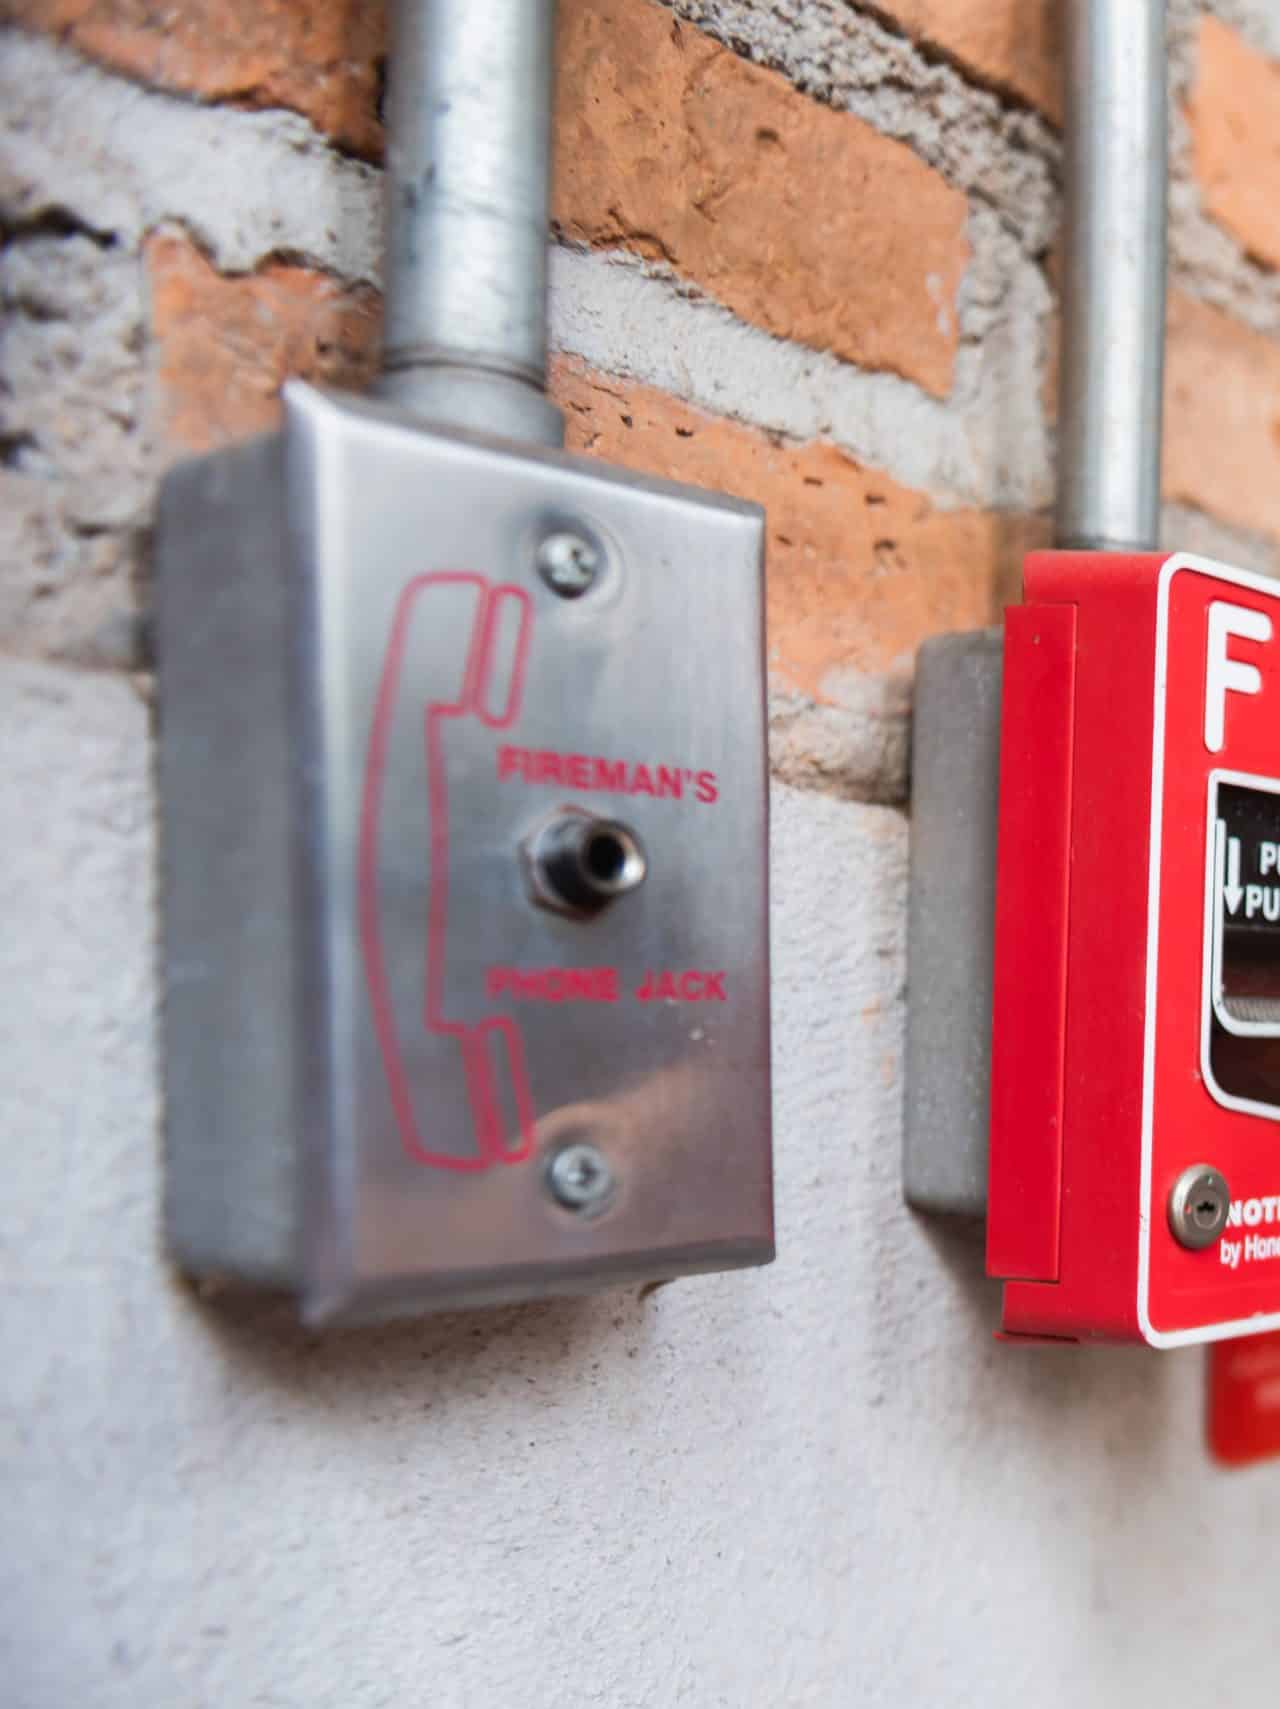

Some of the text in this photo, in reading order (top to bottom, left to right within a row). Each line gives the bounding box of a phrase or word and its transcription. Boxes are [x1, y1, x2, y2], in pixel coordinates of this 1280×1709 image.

[496, 746, 720, 804] FIREMAN'S
[486, 965, 728, 1003] PHONE JACK
[1220, 1238, 1241, 1270] by
